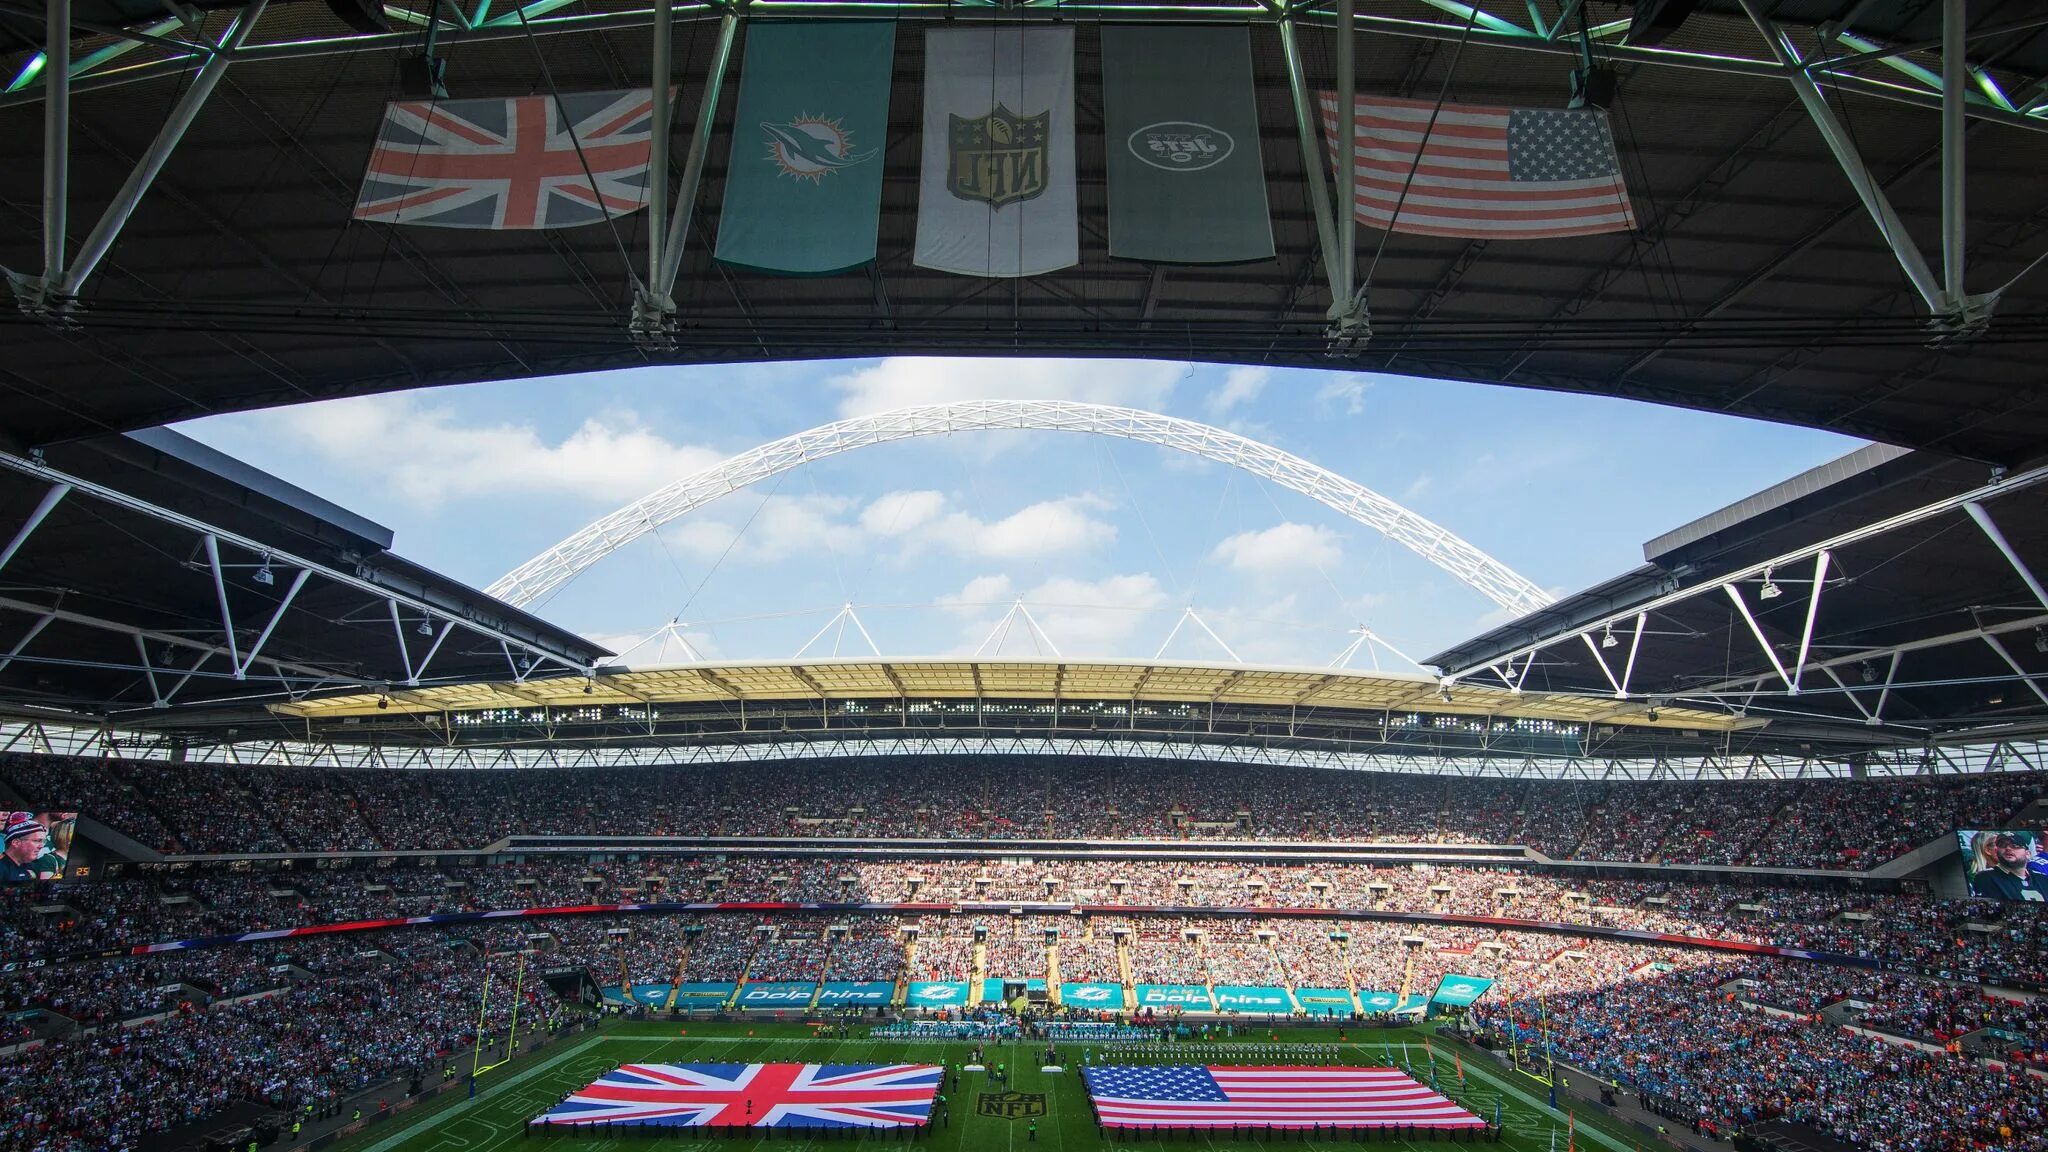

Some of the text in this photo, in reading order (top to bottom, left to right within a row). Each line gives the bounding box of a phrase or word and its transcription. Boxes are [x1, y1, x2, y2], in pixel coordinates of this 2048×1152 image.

[76, 867, 89, 876] 25
[26, 959, 46, 968] 1:43
[1961, 973, 1979, 983] 1:43
[984, 1102, 1041, 1116] NFL
